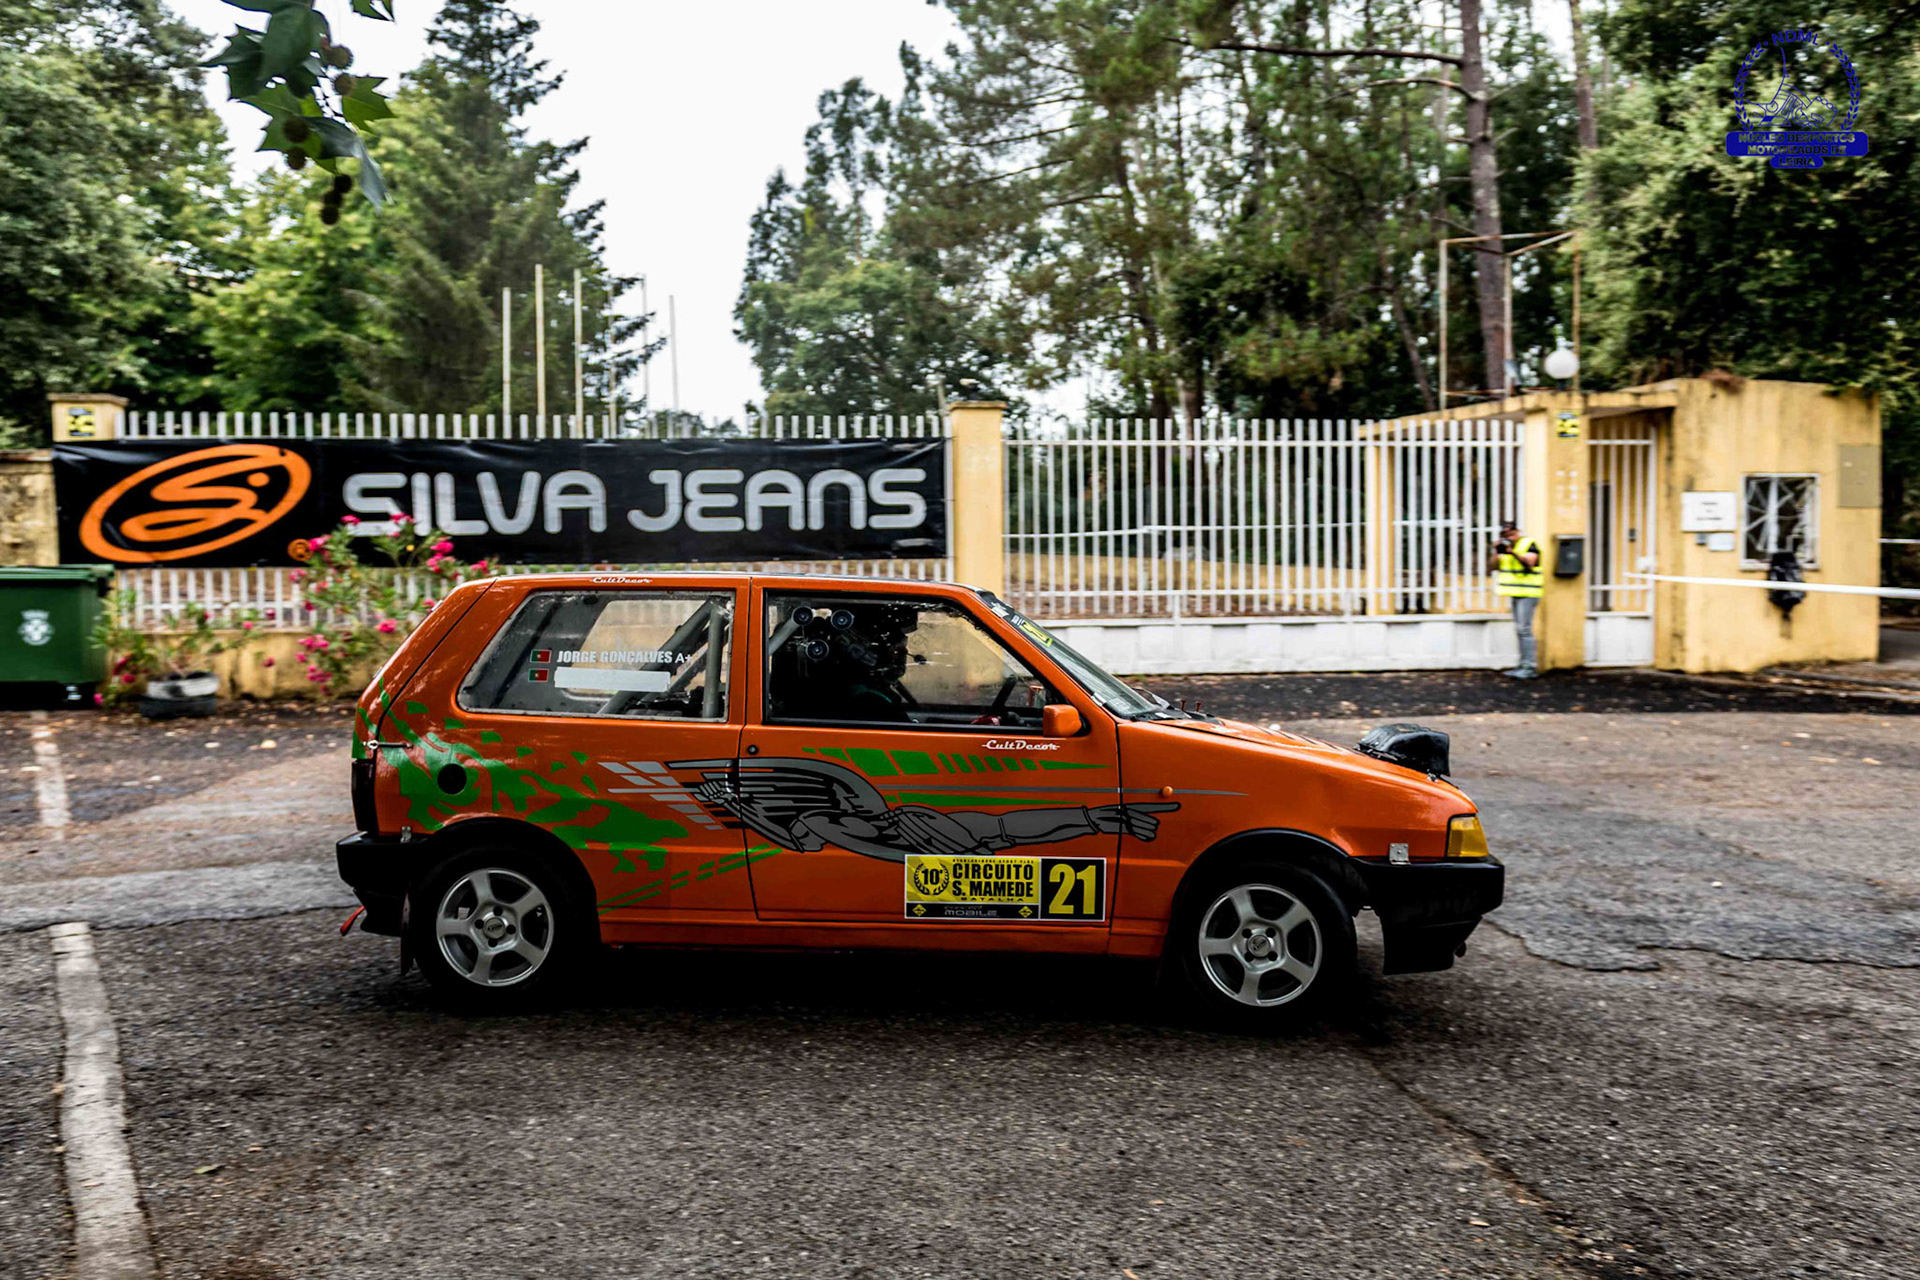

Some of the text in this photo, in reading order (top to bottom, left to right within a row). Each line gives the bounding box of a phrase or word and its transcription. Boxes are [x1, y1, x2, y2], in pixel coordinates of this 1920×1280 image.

[342, 468, 927, 536] SILVA JEANS
[556, 650, 596, 663] JORGE
[982, 739, 1060, 751] CultDecor
[952, 863, 1034, 881] CIRCUITO
[952, 881, 1034, 897] S. MAMEDE
[1048, 863, 1097, 915] 21
